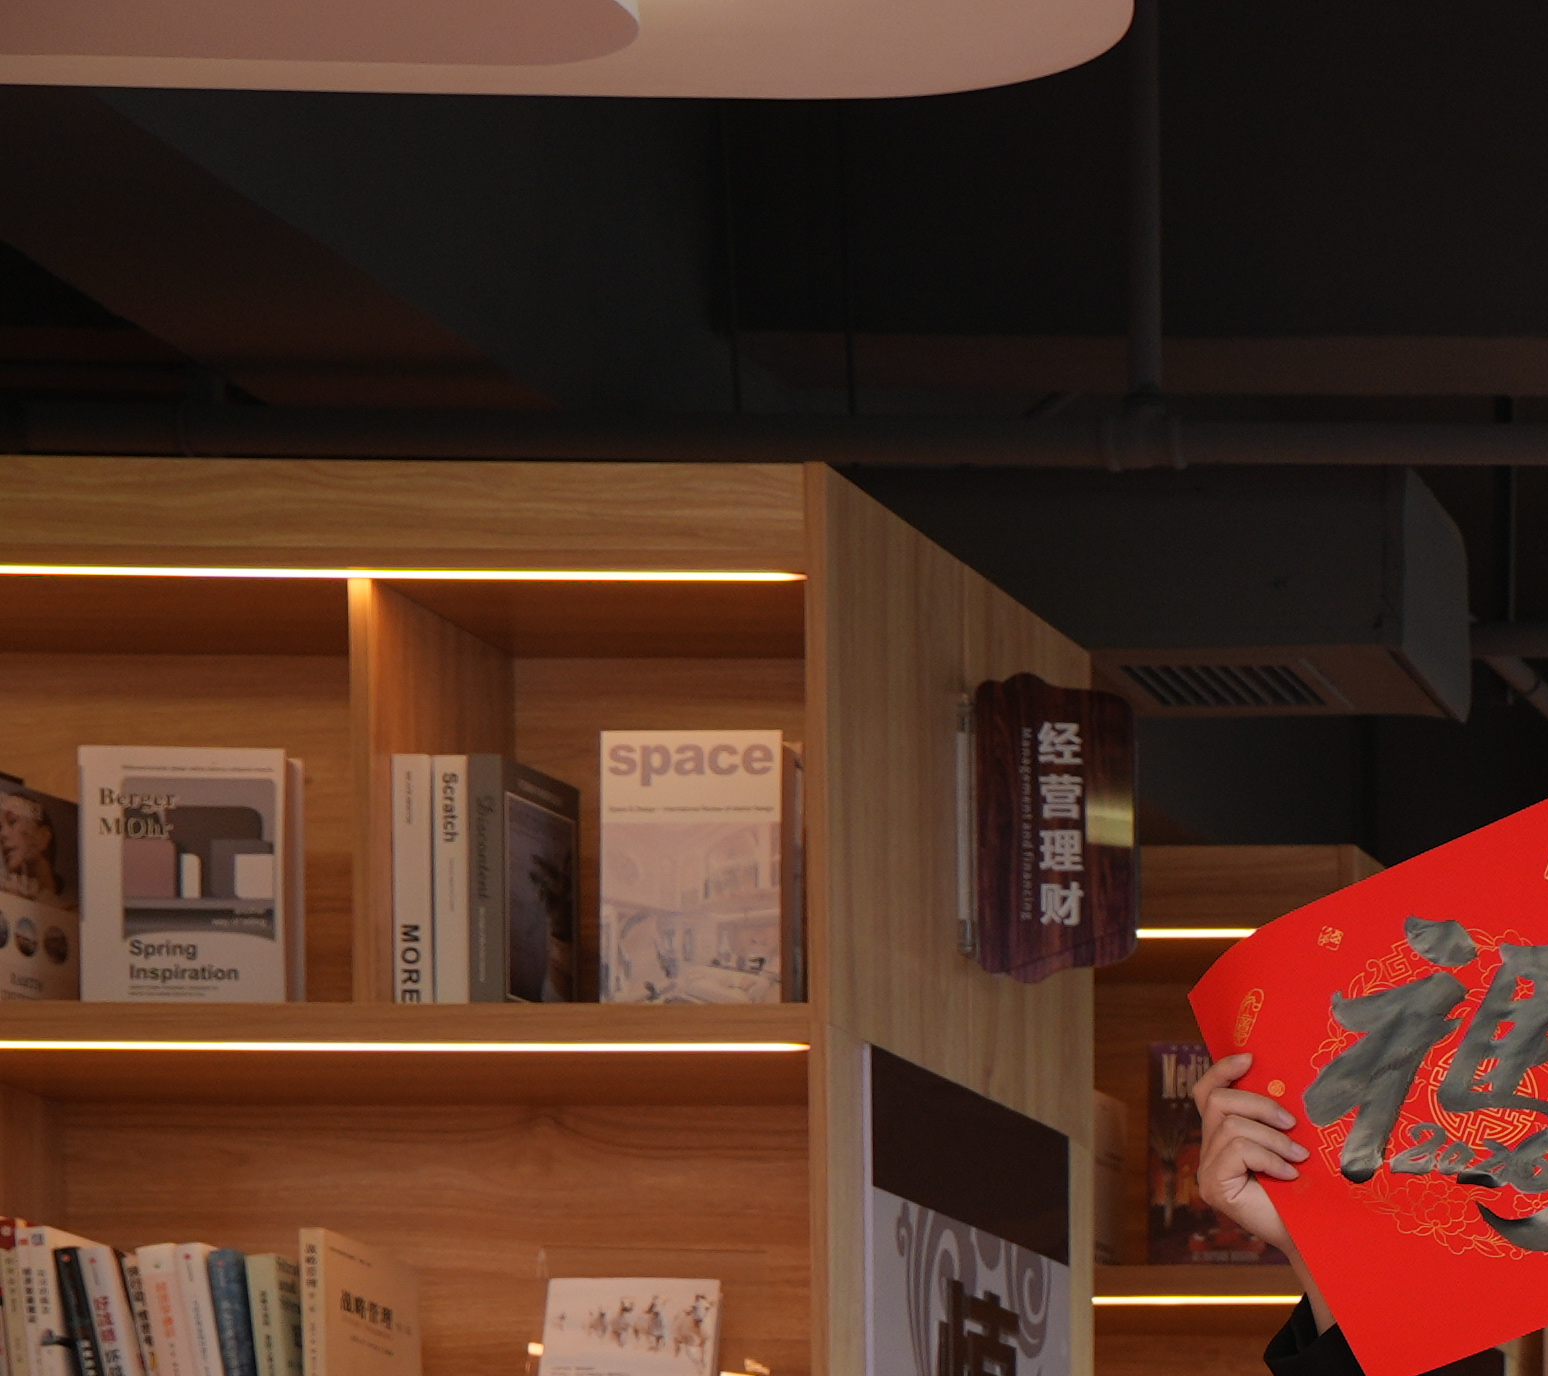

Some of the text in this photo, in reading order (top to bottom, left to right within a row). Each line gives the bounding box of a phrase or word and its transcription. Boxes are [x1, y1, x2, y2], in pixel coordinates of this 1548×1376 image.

[608, 743, 774, 787] space
[99, 787, 176, 813] Berger
[442, 771, 459, 843] Scratch
[1037, 721, 1084, 926] 经营理财
[129, 939, 198, 960] Spring
[401, 923, 421, 1004] MORE
[129, 964, 240, 981] Inspiration
